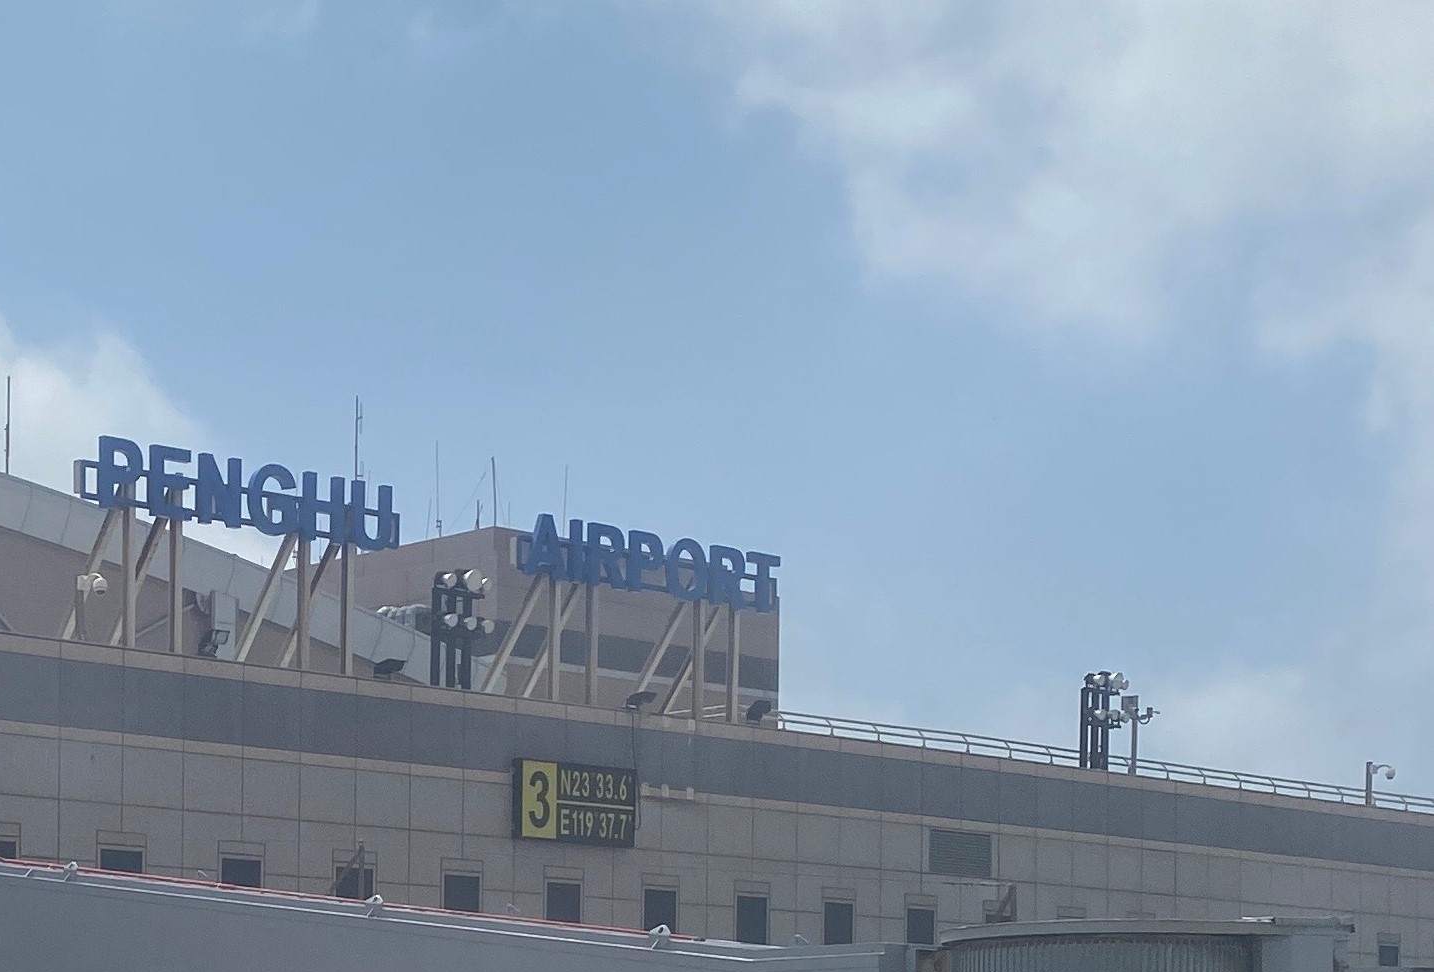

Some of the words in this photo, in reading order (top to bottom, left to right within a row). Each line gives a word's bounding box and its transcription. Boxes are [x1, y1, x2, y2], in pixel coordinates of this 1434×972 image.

[98, 435, 396, 550] PENGHU
[521, 513, 780, 611] AIRPORT
[529, 771, 550, 828] 3
